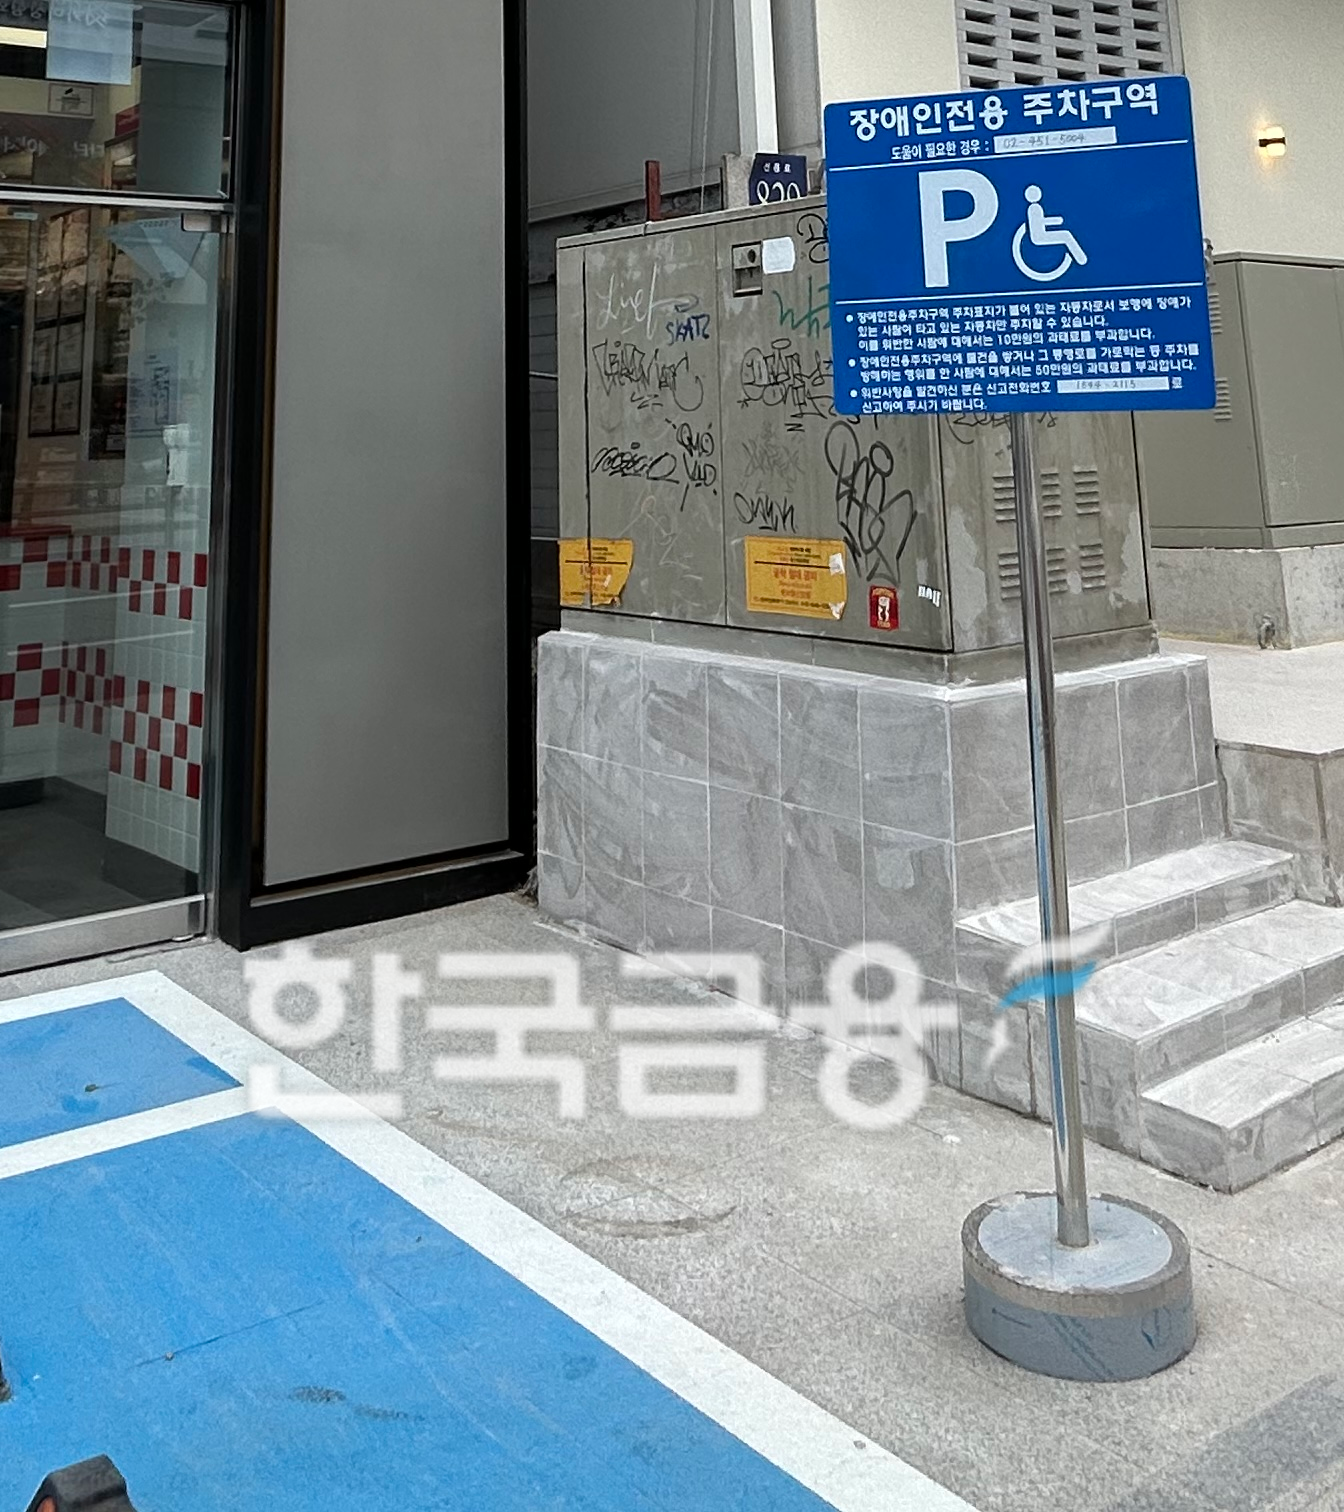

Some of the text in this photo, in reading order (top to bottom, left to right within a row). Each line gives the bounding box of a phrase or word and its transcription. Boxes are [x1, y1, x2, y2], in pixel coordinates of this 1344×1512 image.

[849, 83, 1160, 142] 장애인전용 주차구역
[890, 143, 922, 161] 도움이
[925, 140, 957, 159] 필요한
[959, 139, 981, 156] 경우
[919, 168, 1000, 288] P
[857, 307, 949, 324] 장애인전용주차구역
[952, 304, 1006, 318] 주차표지가
[1034, 303, 1056, 315] 있는
[1060, 300, 1115, 314] 자동차로서
[1156, 296, 1192, 310] 장애가
[858, 326, 878, 338] 있는
[916, 323, 936, 334] 타고
[940, 322, 961, 334] 있는
[964, 320, 1007, 333] 자동차만
[1047, 318, 1057, 329] 수
[1061, 315, 1109, 328] 있습니다.
[858, 340, 879, 351] 이를
[882, 338, 913, 350] 위반한
[860, 351, 963, 368] 장애인전용주차구역에
[1038, 350, 1048, 361] 그
[1165, 343, 1199, 356] 주차를
[939, 367, 950, 379] 한
[987, 380, 1051, 395] 신고전화번호
[906, 399, 938, 412] 주시기
